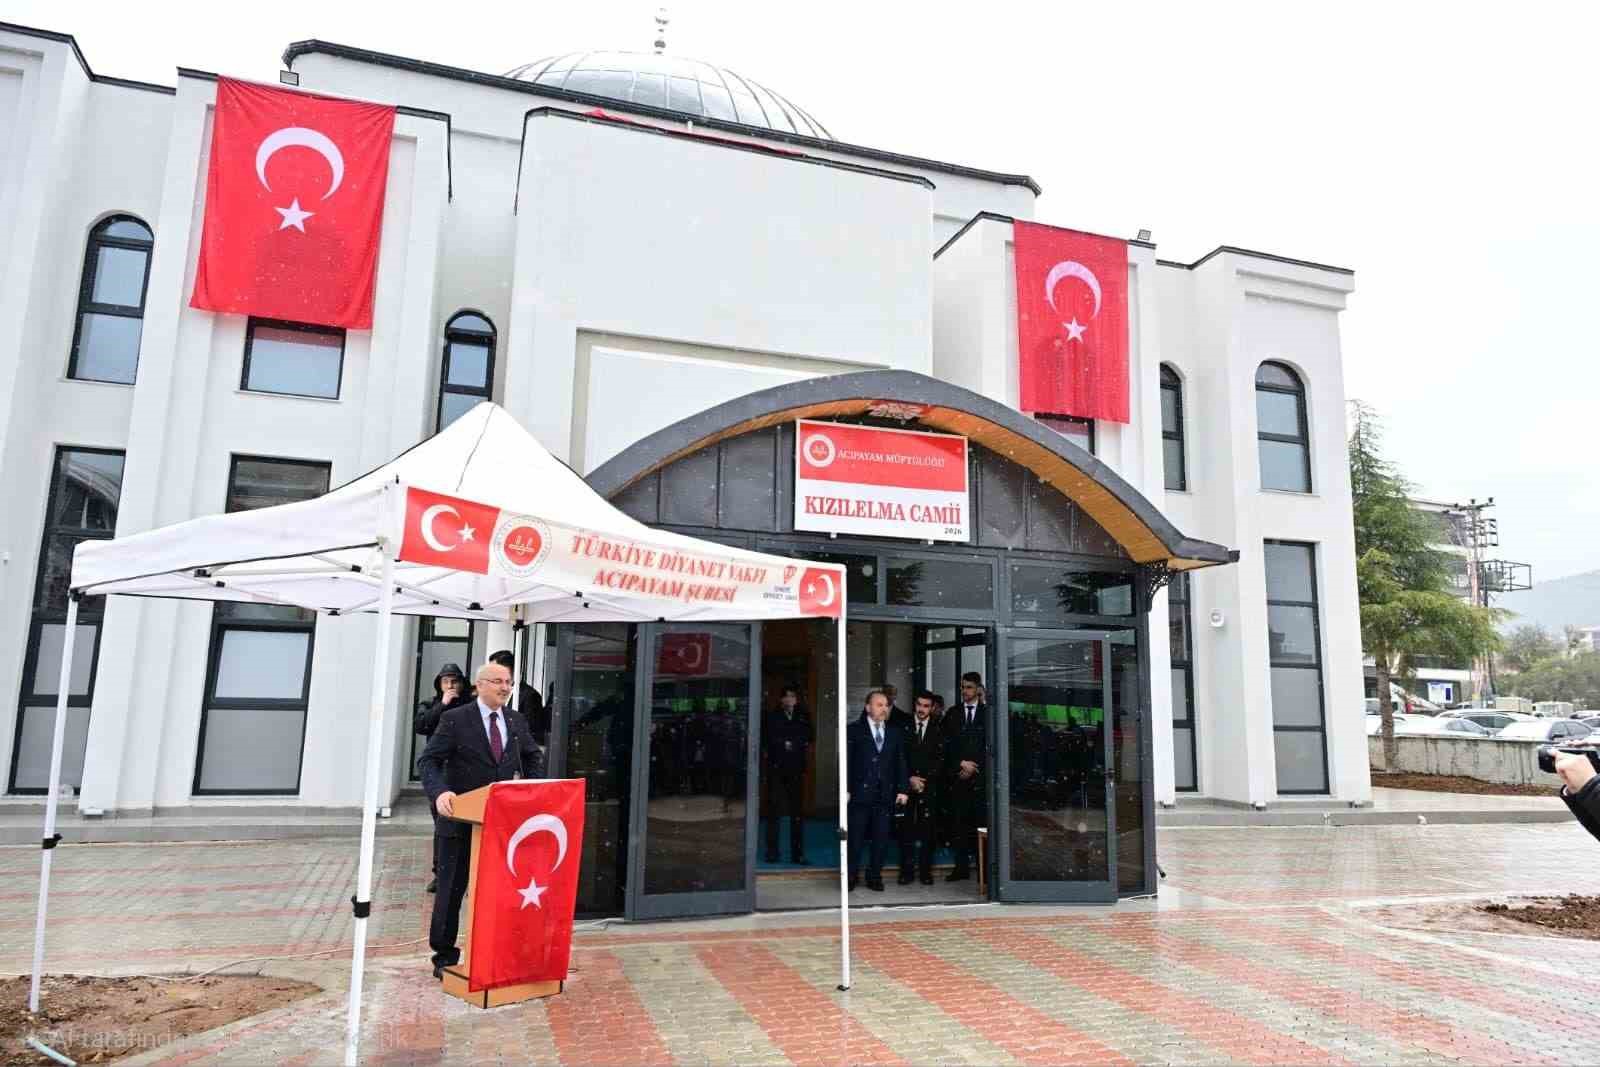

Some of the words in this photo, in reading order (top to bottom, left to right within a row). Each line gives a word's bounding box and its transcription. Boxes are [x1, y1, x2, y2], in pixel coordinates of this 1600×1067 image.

[837, 449, 884, 464] ACIPAYAM
[804, 495, 906, 521] KIZILELMA
[909, 502, 961, 525] CAMİİ
[570, 533, 657, 568] TÜRKİYE
[658, 551, 728, 579] DİYANET
[728, 562, 768, 584] VAKFI
[592, 568, 685, 599] ACIPAYAM
[686, 582, 739, 604] ŞUBESİ
